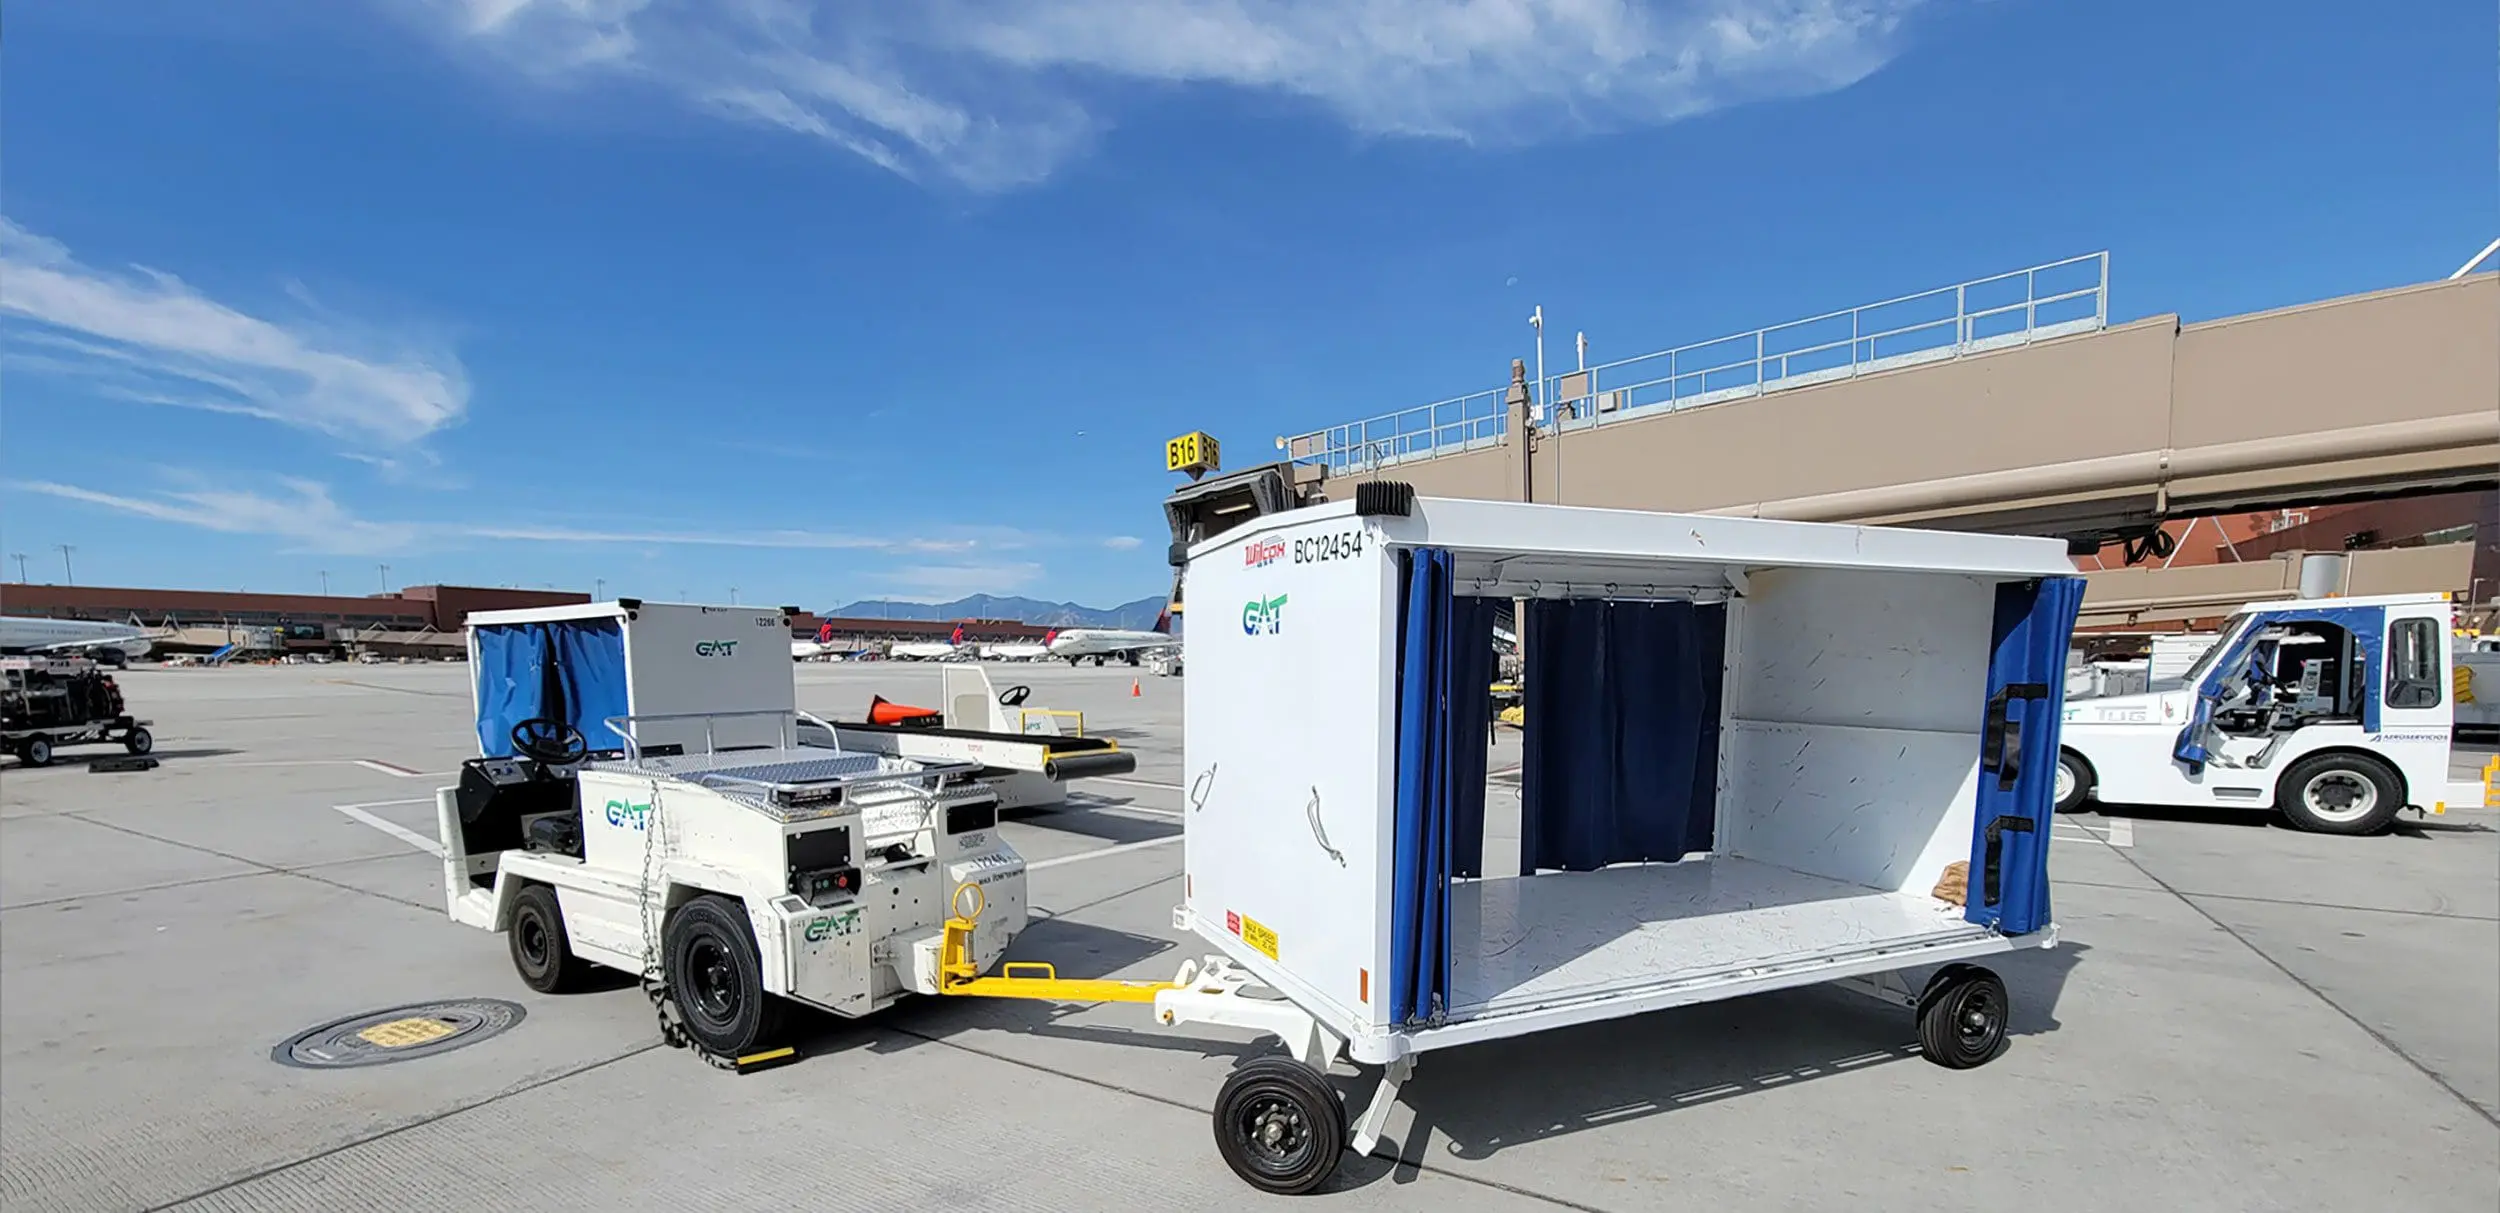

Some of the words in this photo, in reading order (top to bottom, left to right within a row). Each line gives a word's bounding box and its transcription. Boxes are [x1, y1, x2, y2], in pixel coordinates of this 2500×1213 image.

[1170, 436, 1195, 467] B16
[1294, 530, 1362, 564] BC12454
[1243, 594, 1288, 636] GAT
[695, 640, 738, 657] GAT
[606, 798, 651, 831] GAT
[805, 908, 859, 942] GAT
